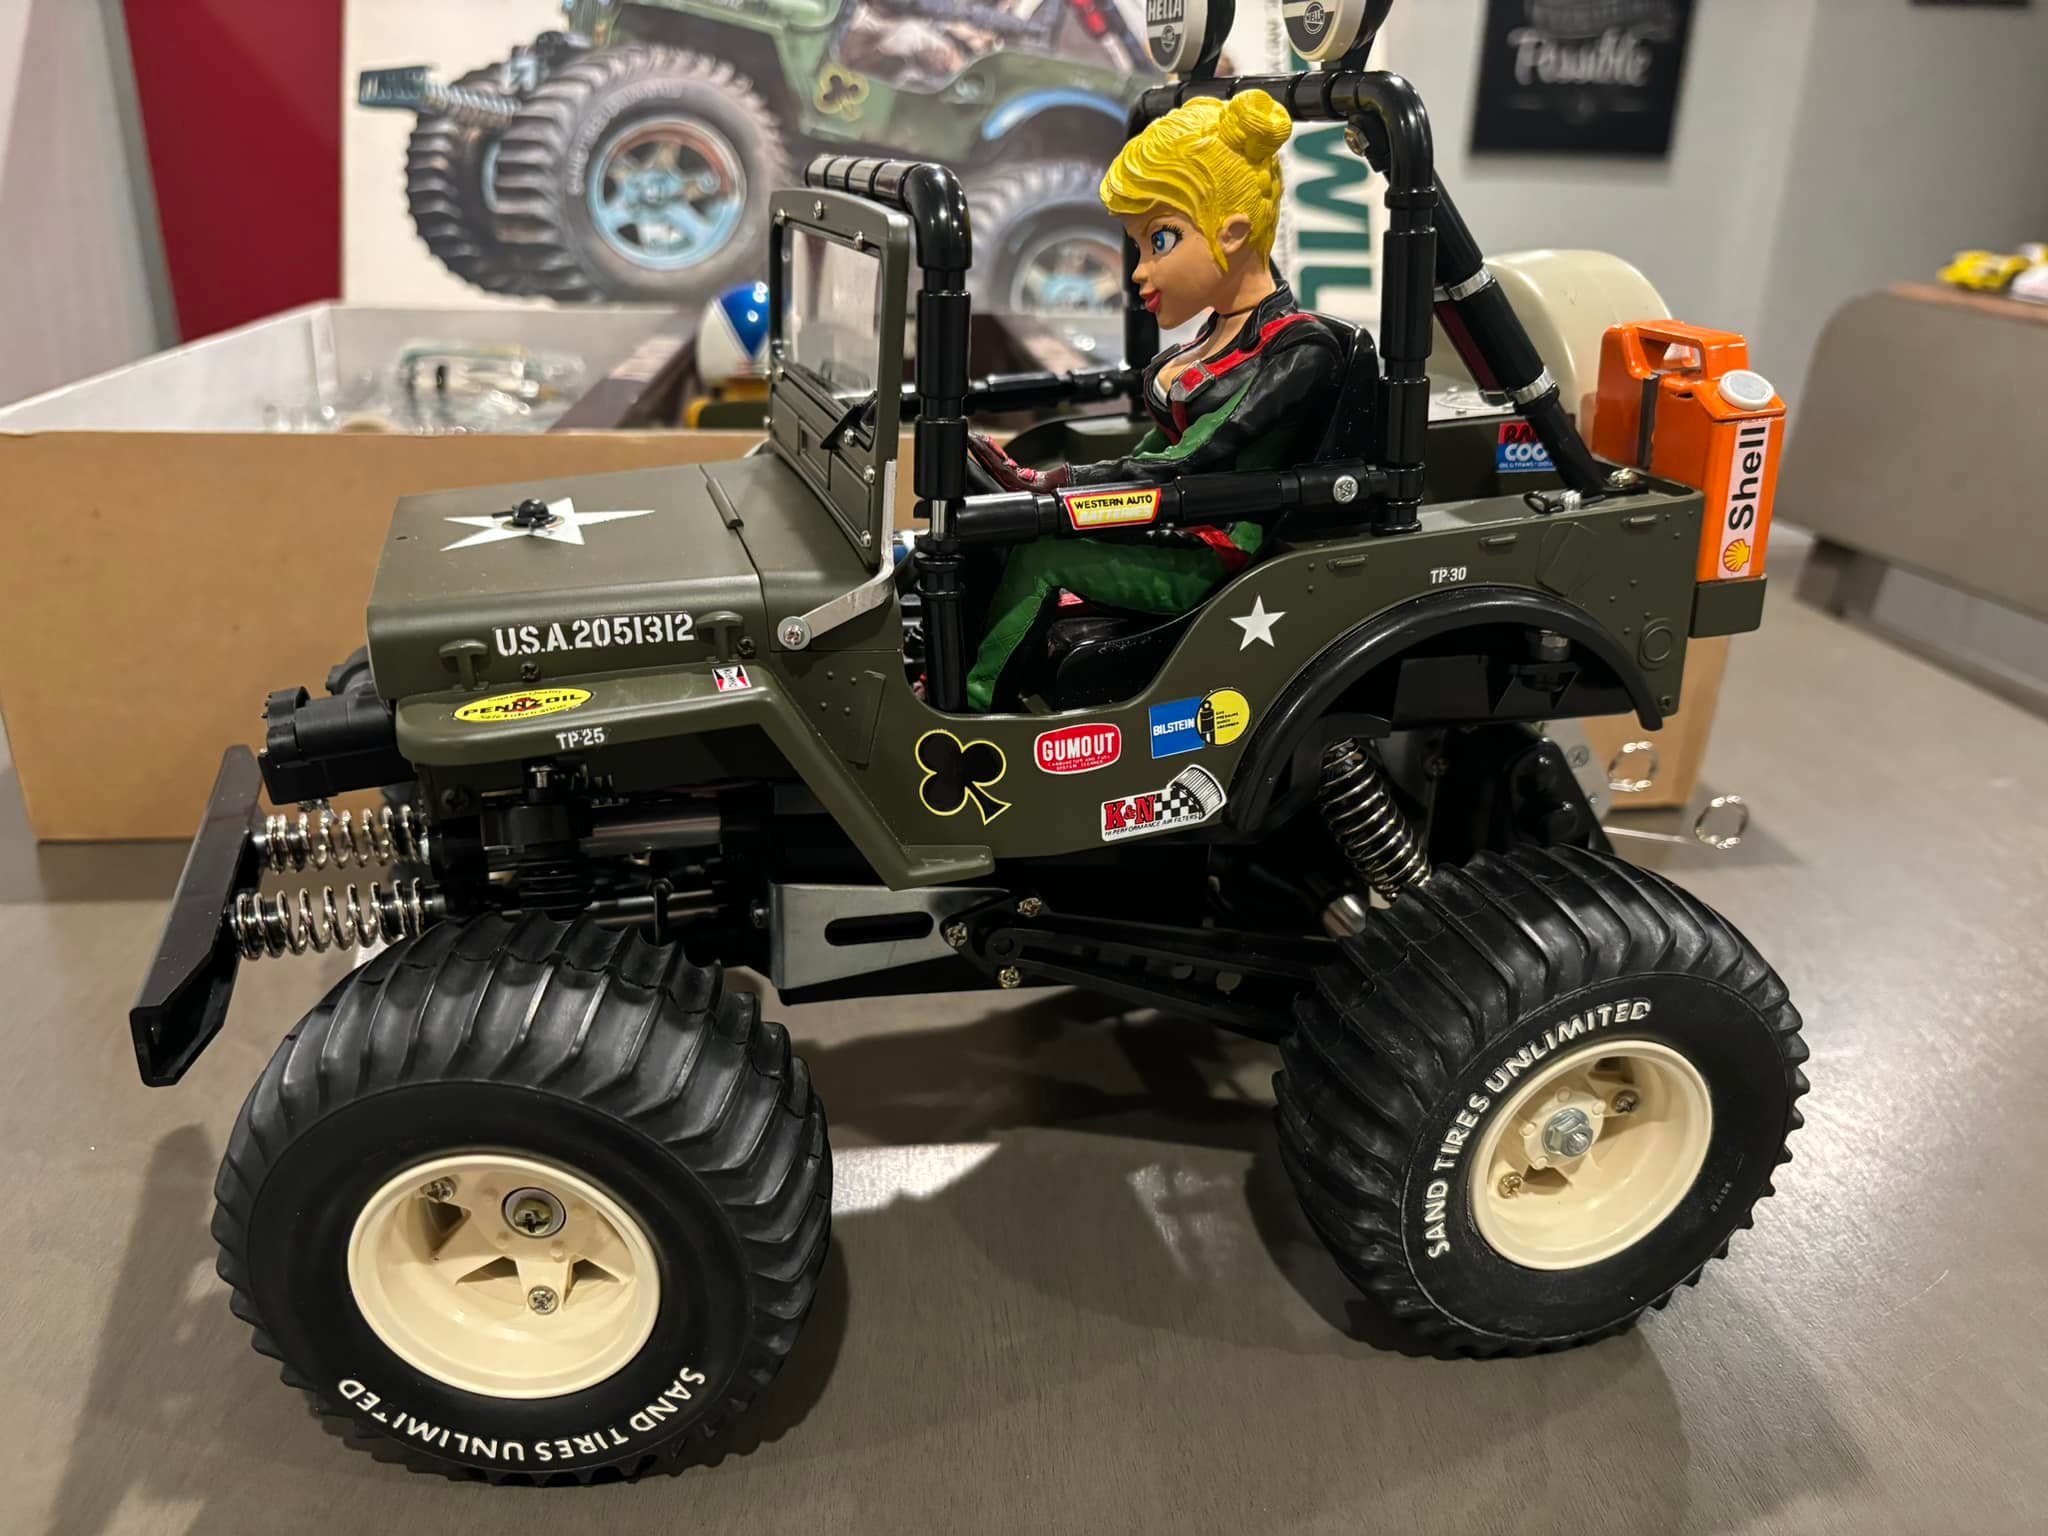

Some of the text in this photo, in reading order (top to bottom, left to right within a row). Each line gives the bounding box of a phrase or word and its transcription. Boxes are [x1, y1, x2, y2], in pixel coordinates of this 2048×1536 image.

[1147, 0, 1183, 21] HELLA
[1729, 425, 1766, 530] Shell
[1074, 494, 1153, 509] WESTERN AUTO
[463, 694, 583, 716] PENNZOIL
[1153, 718, 1195, 736] BILSTEIN
[1042, 732, 1115, 761] GUMOUT
[1104, 794, 1156, 831] K&N
[1423, 997, 1652, 1259] SAND TIRES UNLIMITED
[337, 1367, 707, 1462] SAND TIRES UNLIMITED
